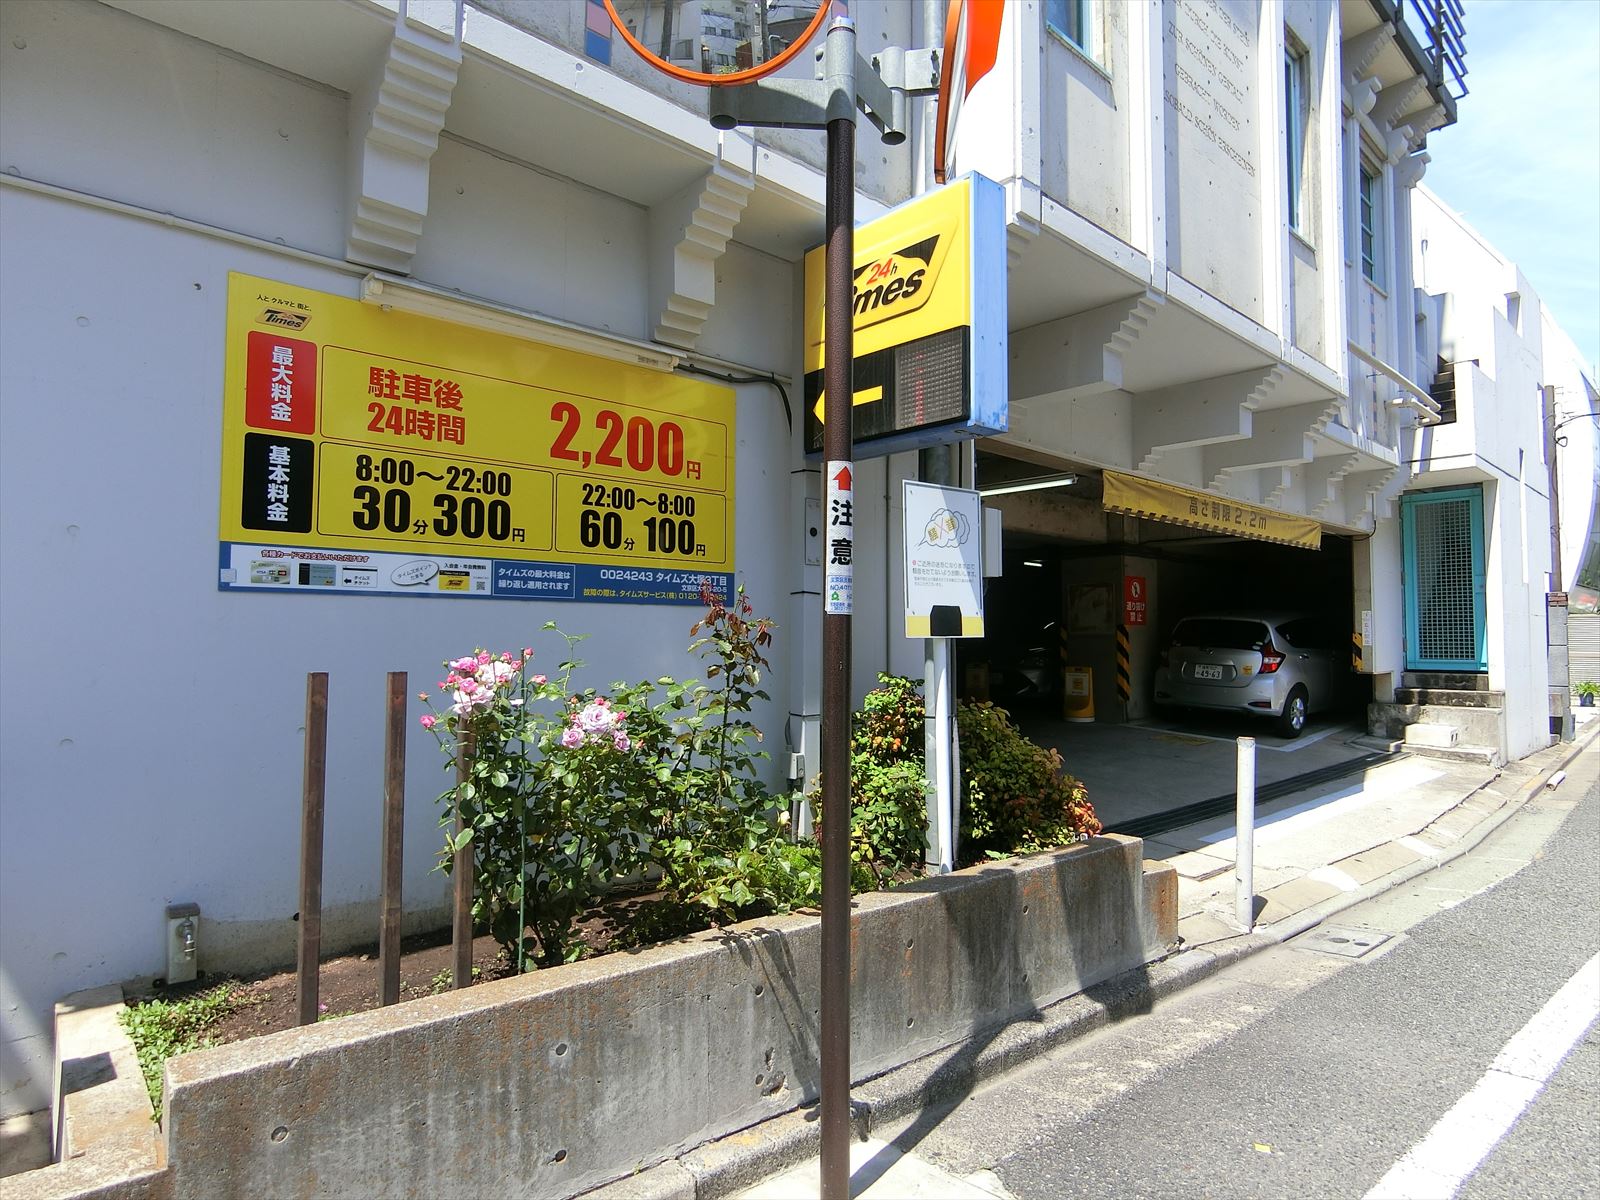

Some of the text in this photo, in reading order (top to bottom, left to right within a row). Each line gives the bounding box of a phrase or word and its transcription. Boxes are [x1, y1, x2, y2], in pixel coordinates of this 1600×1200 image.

[853, 268, 926, 317] mes
[866, 258, 898, 286] 24h
[265, 313, 303, 328] Times
[271, 345, 293, 422] 最大料金
[367, 366, 464, 412] 駐車後
[367, 402, 466, 446] 24時間
[266, 445, 291, 522] 基本料金
[498, 567, 571, 580] タイムズの最大料金は
[600, 569, 653, 582] 0024243
